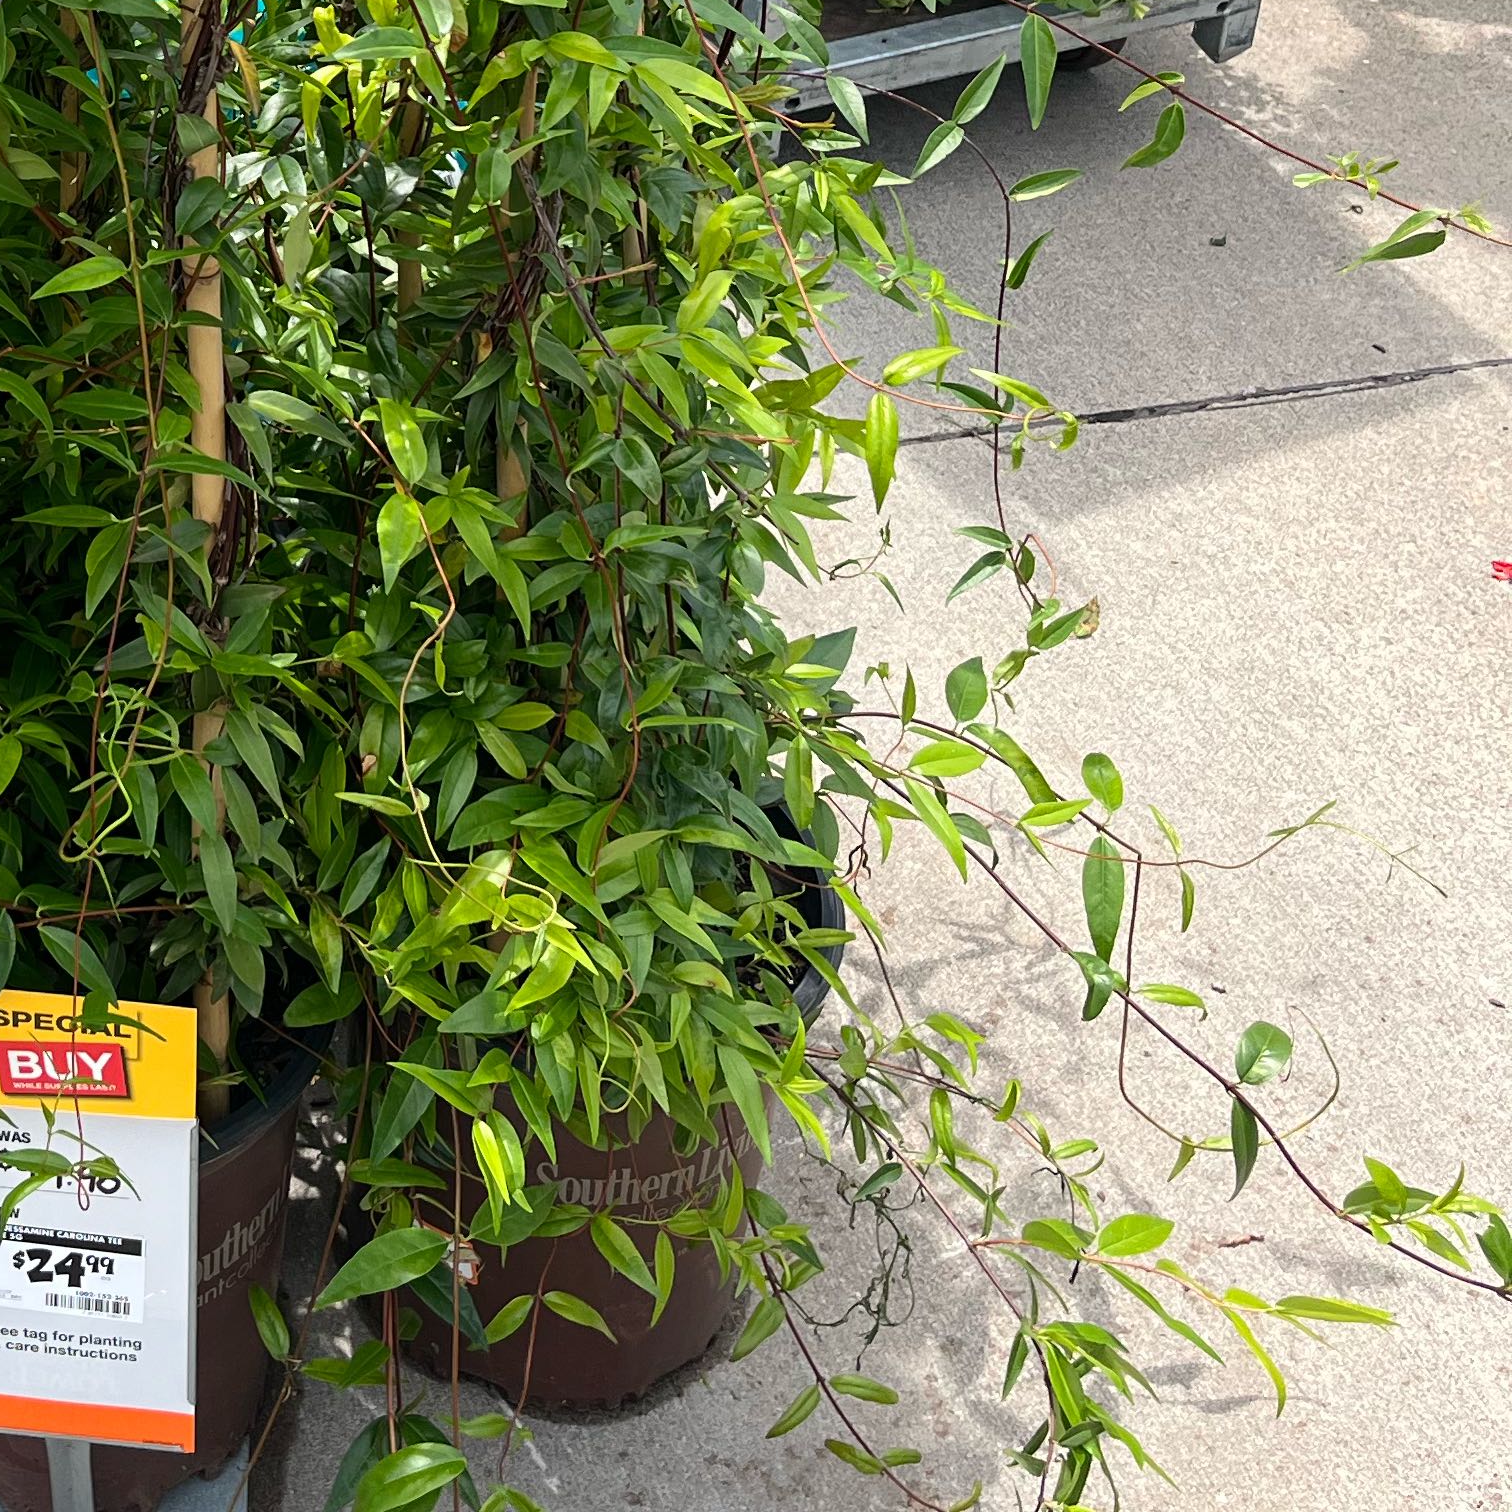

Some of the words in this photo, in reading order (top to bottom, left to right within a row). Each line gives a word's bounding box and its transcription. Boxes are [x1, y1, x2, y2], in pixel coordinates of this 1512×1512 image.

[6, 1049, 113, 1081] BUY
[56, 1230, 106, 1244] CAROLINA
[23, 1327, 48, 1343] tag
[52, 1330, 74, 1344] for
[79, 1334, 143, 1351] planting
[6, 1342, 39, 1353] care
[44, 1345, 138, 1363] instructions
